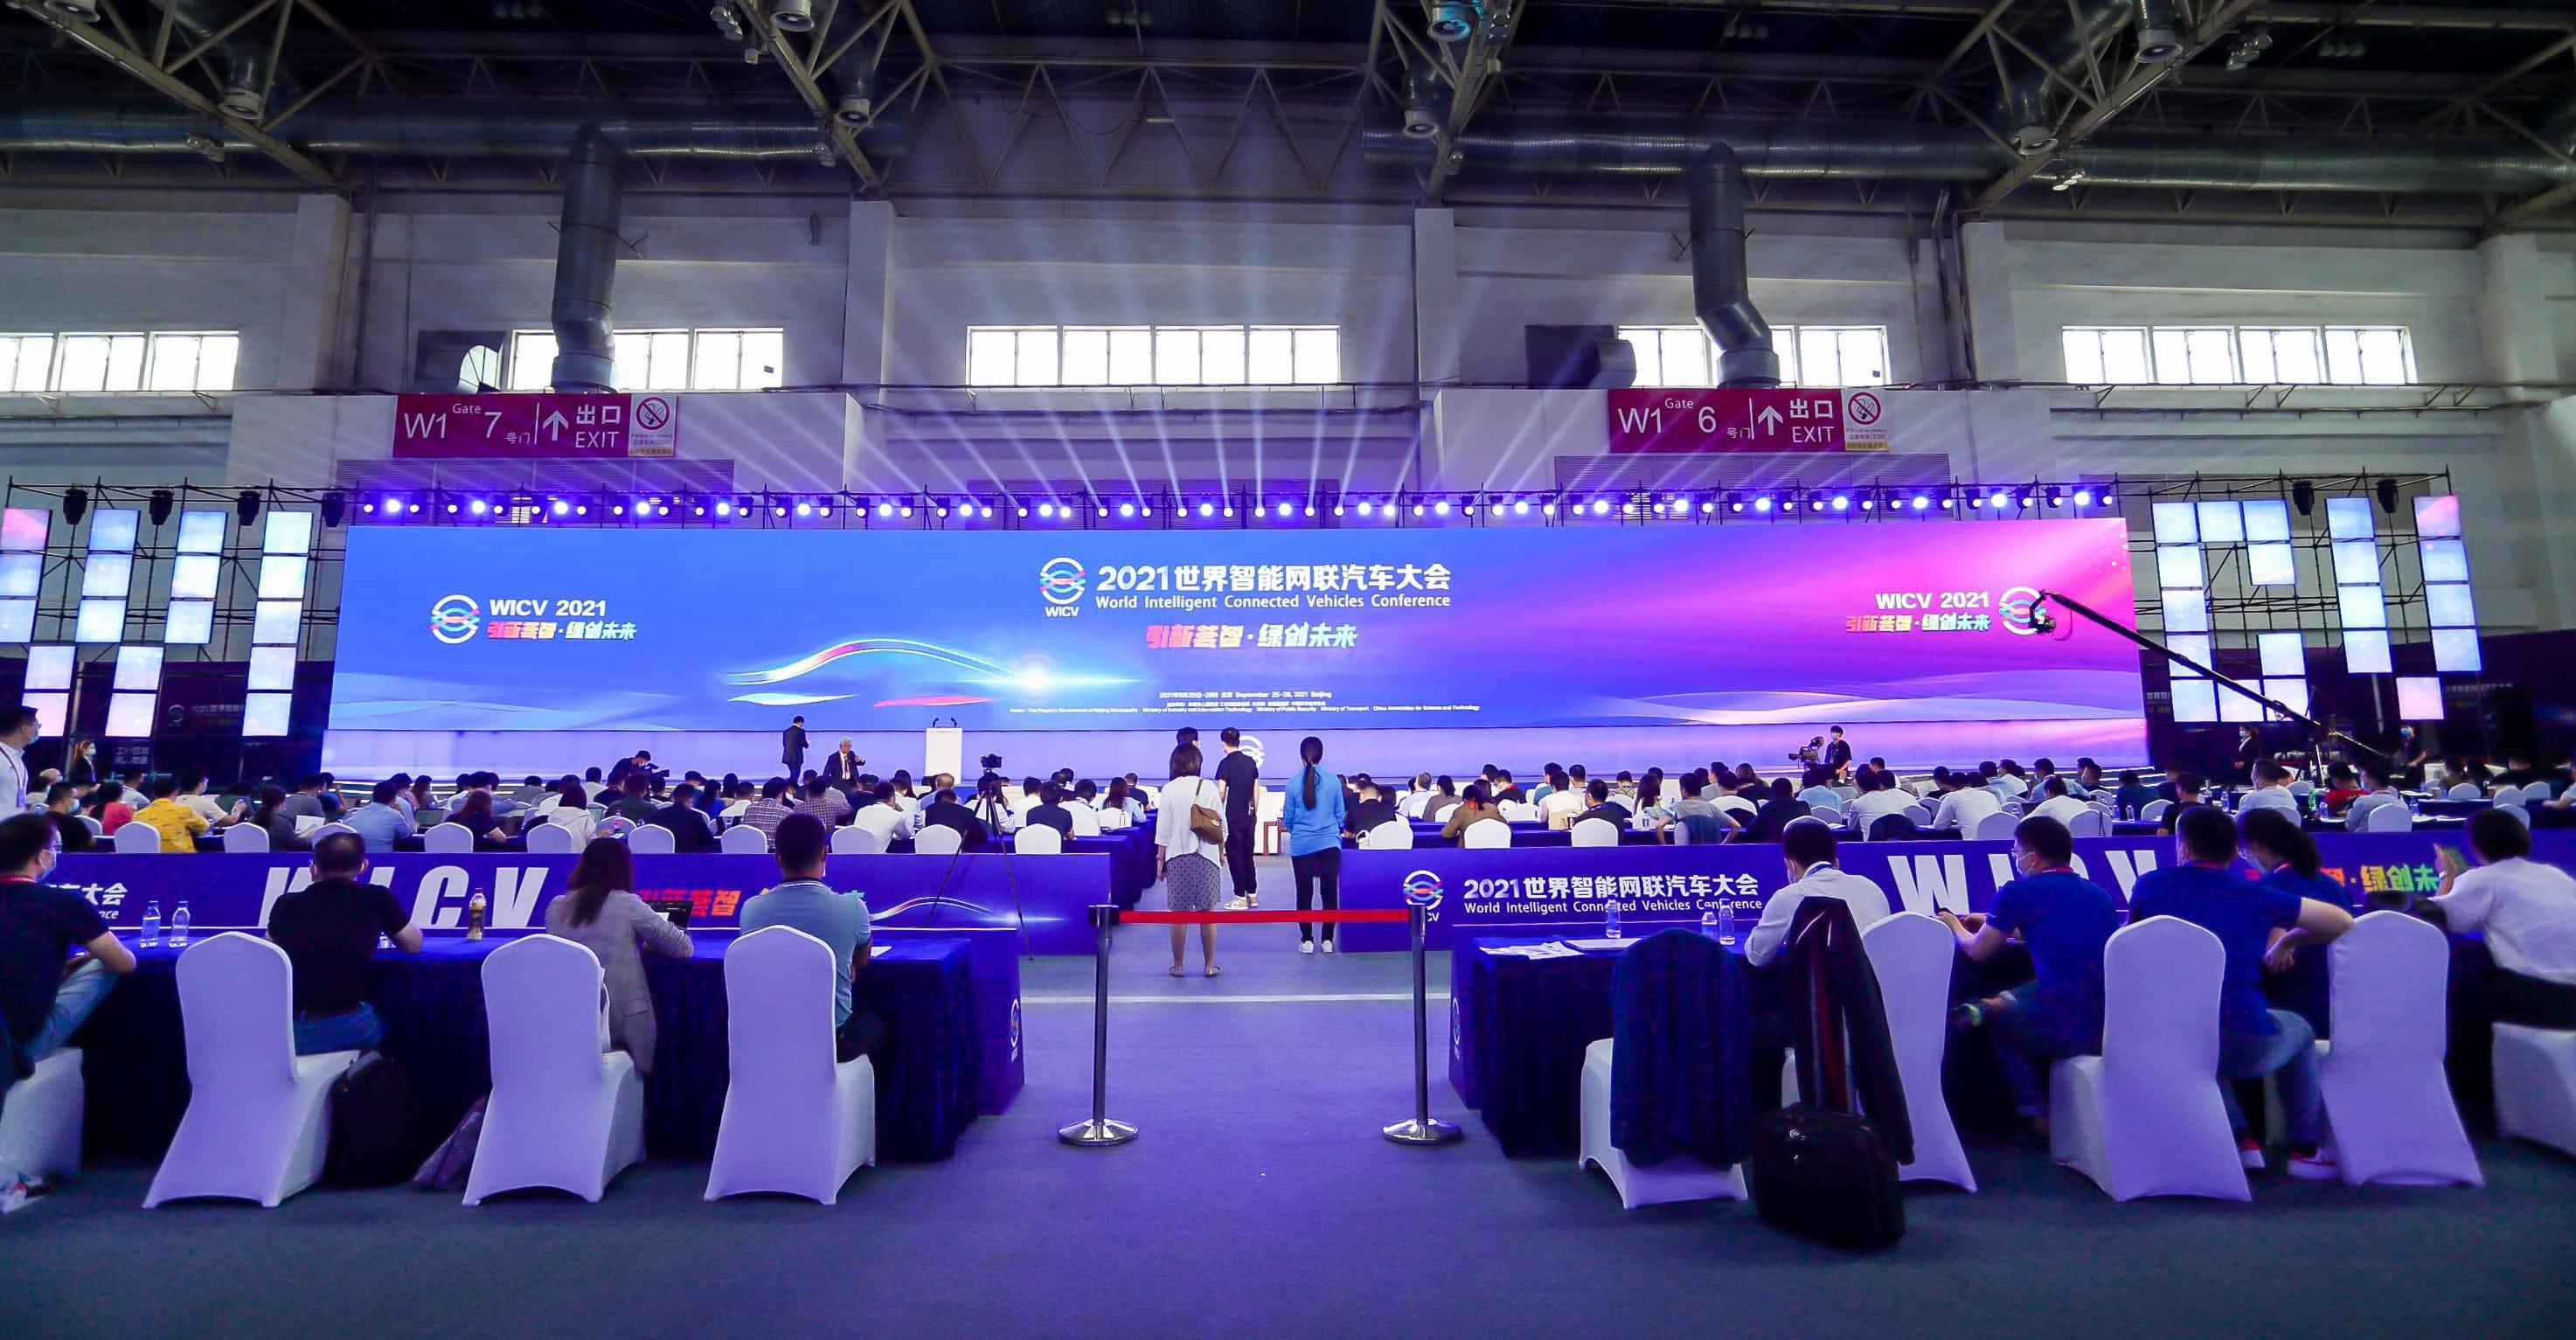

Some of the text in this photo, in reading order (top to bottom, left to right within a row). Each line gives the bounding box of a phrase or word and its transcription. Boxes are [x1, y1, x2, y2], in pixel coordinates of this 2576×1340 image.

[576, 404, 621, 425] 出口
[1789, 399, 1834, 419] 出口
[404, 403, 531, 444] W1 Gate 7 号门
[1618, 398, 1752, 440] W1 Gate 6 号门
[575, 432, 620, 448] EXIT
[1792, 426, 1836, 443] EXIT
[1096, 564, 1451, 593] 2021世界智能网联汽车大会
[490, 600, 606, 616] WICV 2021
[1095, 593, 1451, 611] World Intelligent Connected Vehicles Conference
[1875, 592, 1989, 609] WICV 2021
[1045, 606, 1079, 617] WICV
[1463, 873, 1759, 899] 2021世界智能网联汽车大会
[1464, 902, 1500, 913] World
[1506, 902, 1568, 915] Intelligent
[1573, 900, 1636, 913] Connted
[1642, 899, 1691, 912] Vehicles
